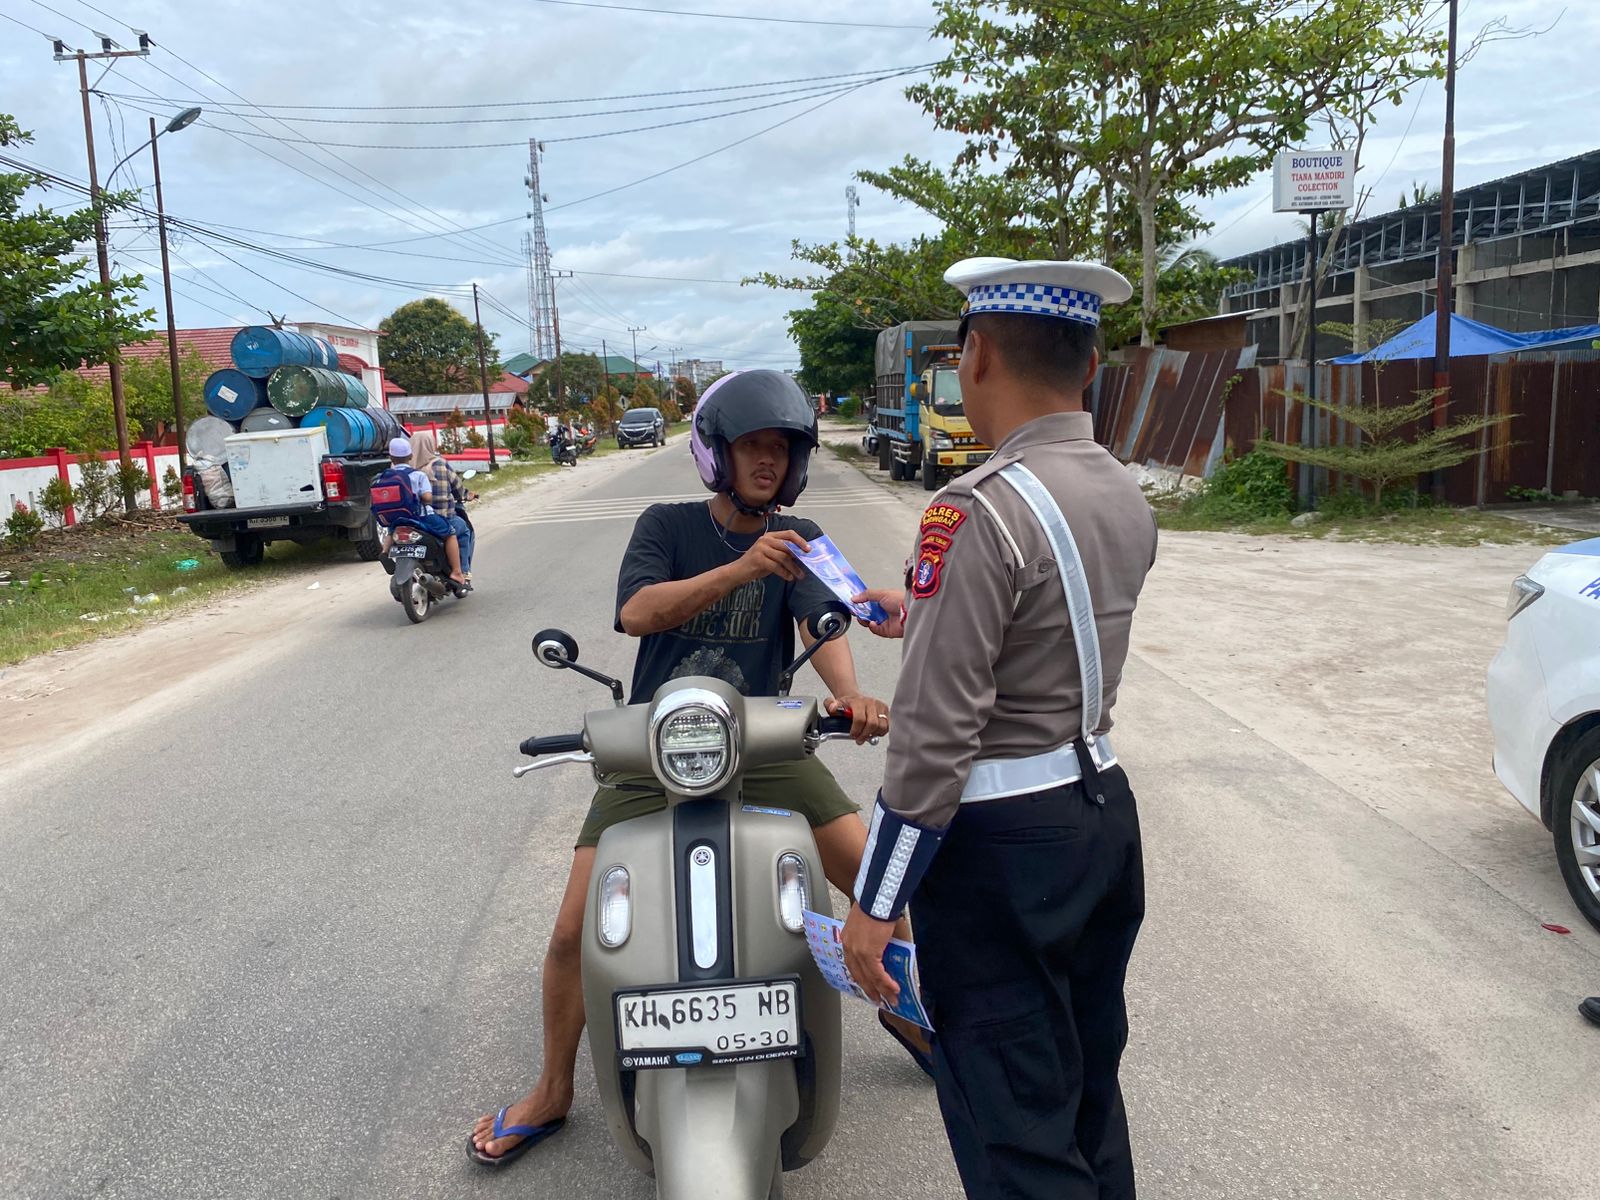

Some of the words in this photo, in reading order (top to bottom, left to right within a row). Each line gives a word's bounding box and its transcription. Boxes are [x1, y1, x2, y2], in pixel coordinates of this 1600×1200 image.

[1292, 156, 1342, 169] BOUTIQUE
[1292, 173, 1312, 181] TIANA
[1314, 171, 1344, 180] MANDIRI
[1298, 182, 1338, 192] COLECTION
[625, 999, 658, 1028] KH
[671, 994, 737, 1024] 6635
[758, 989, 790, 1016] NB
[633, 1056, 669, 1066] YAMAHA
[712, 1055, 754, 1064] SEMAKIN
[766, 1050, 798, 1060] DEPAN
